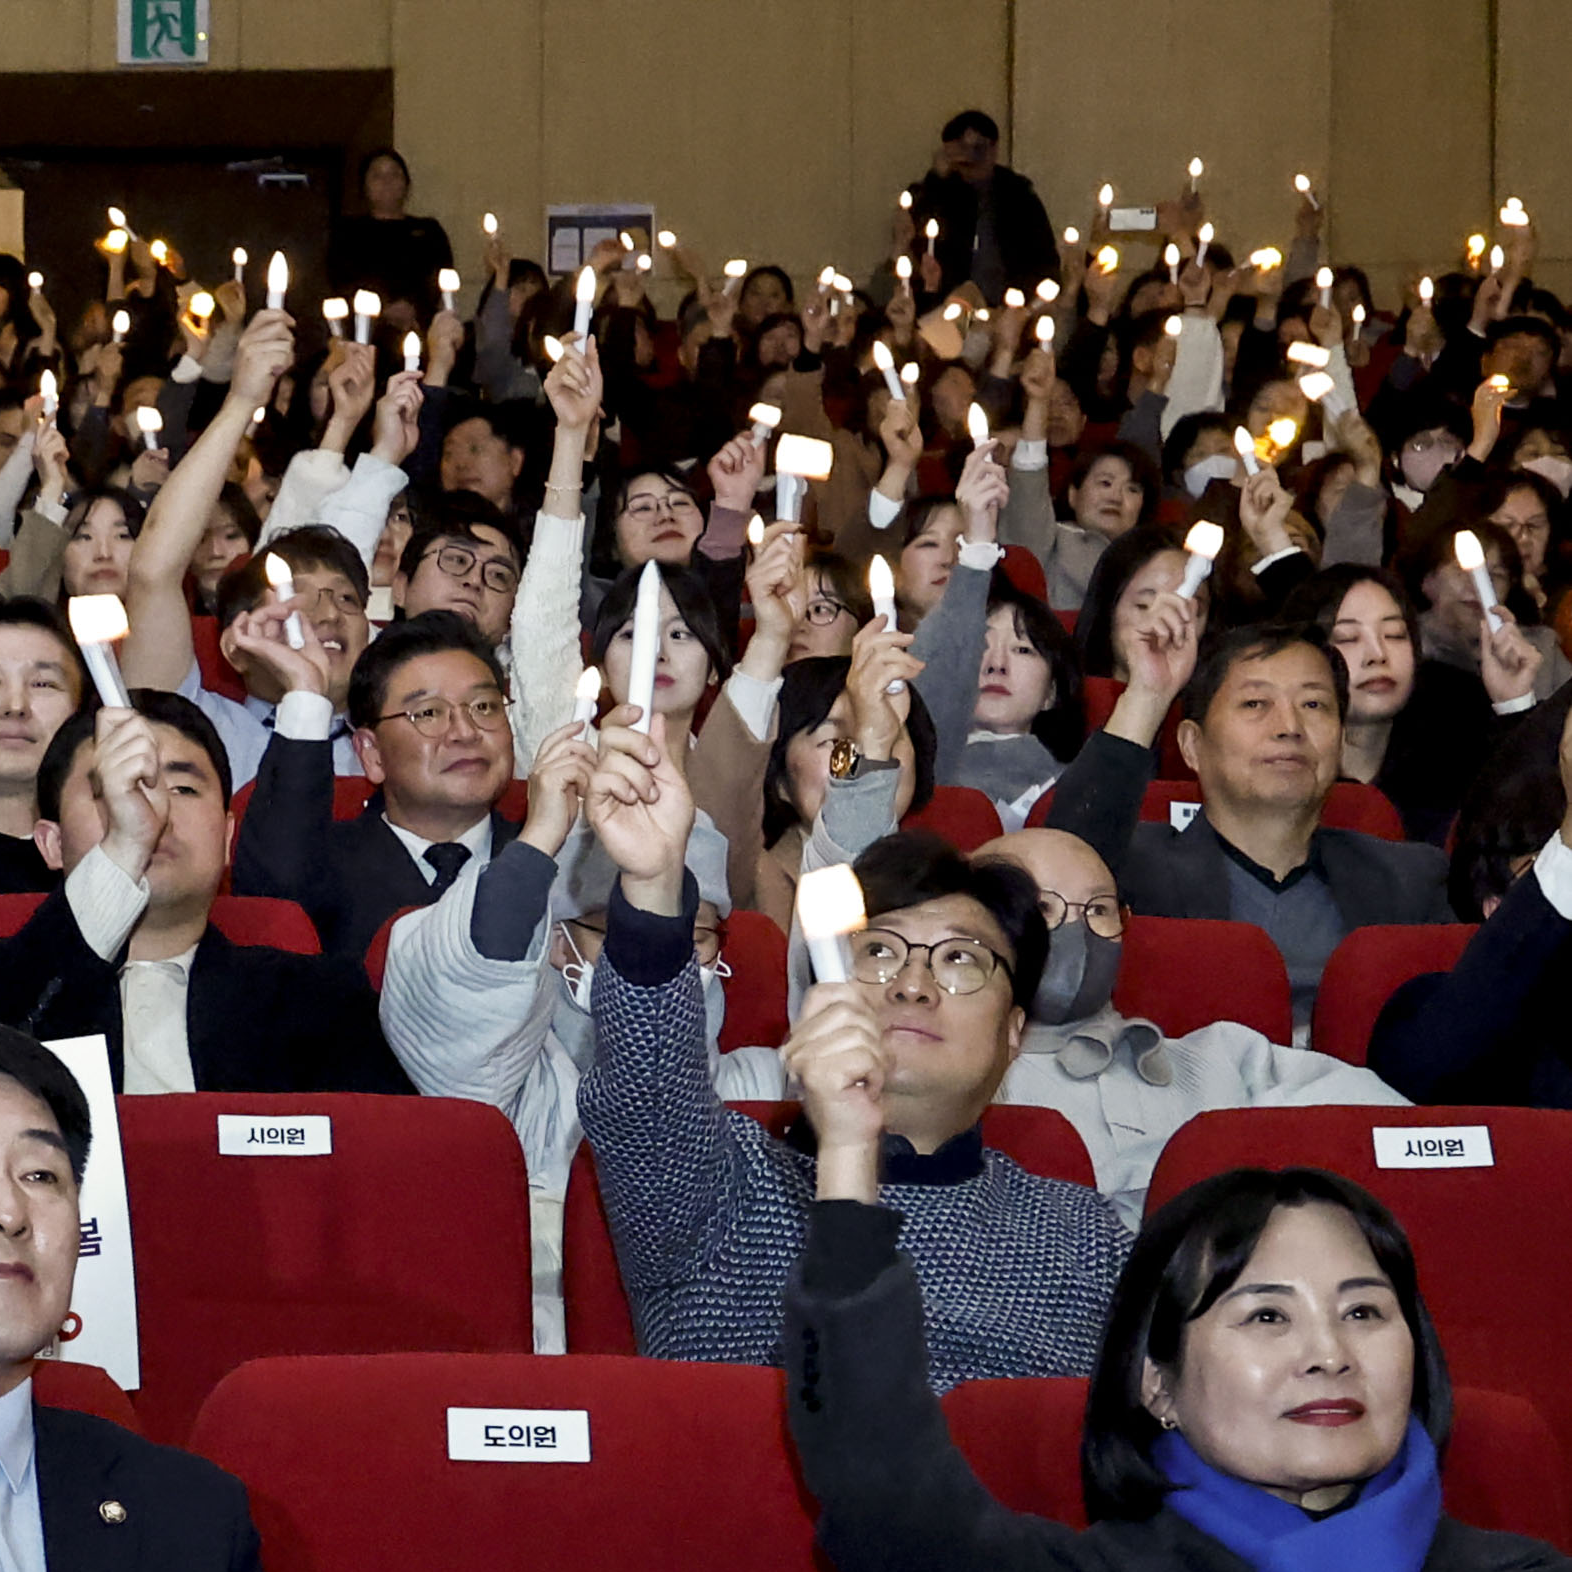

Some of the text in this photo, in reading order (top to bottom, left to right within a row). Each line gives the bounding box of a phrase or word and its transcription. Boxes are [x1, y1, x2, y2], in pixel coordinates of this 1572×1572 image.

[246, 1127, 305, 1145] 시의원
[1404, 1138, 1465, 1158] 시의원
[484, 1425, 557, 1449] 도의원
